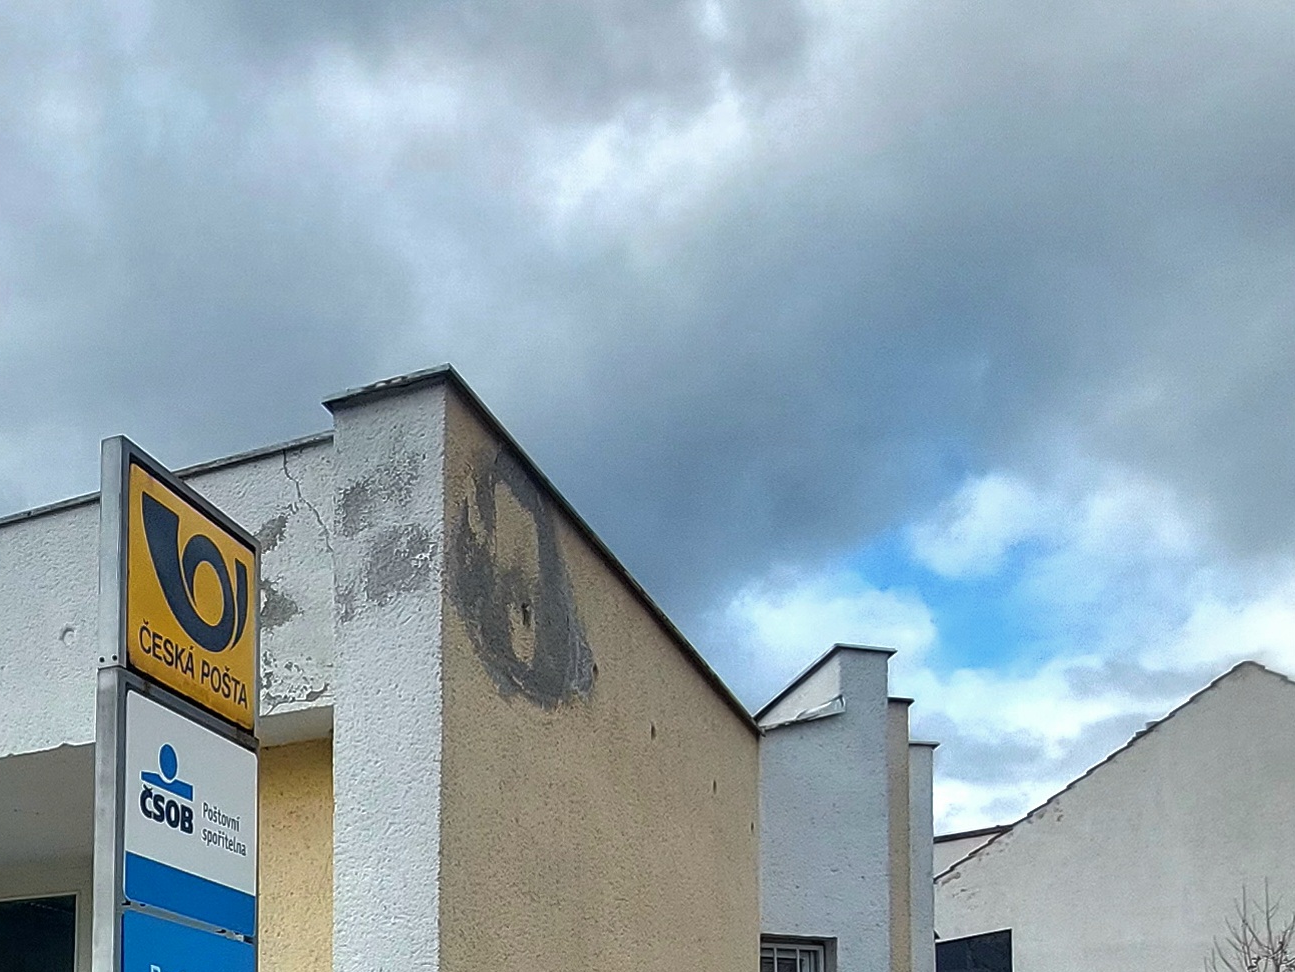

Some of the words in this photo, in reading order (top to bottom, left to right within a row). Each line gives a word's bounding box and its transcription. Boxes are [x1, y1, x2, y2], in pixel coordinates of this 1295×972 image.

[139, 619, 195, 680] ČESKÁ
[200, 658, 248, 710] POŠTA
[139, 784, 194, 835] ČSOB
[202, 802, 241, 832] Poštovní
[201, 828, 247, 857] spořitelna
